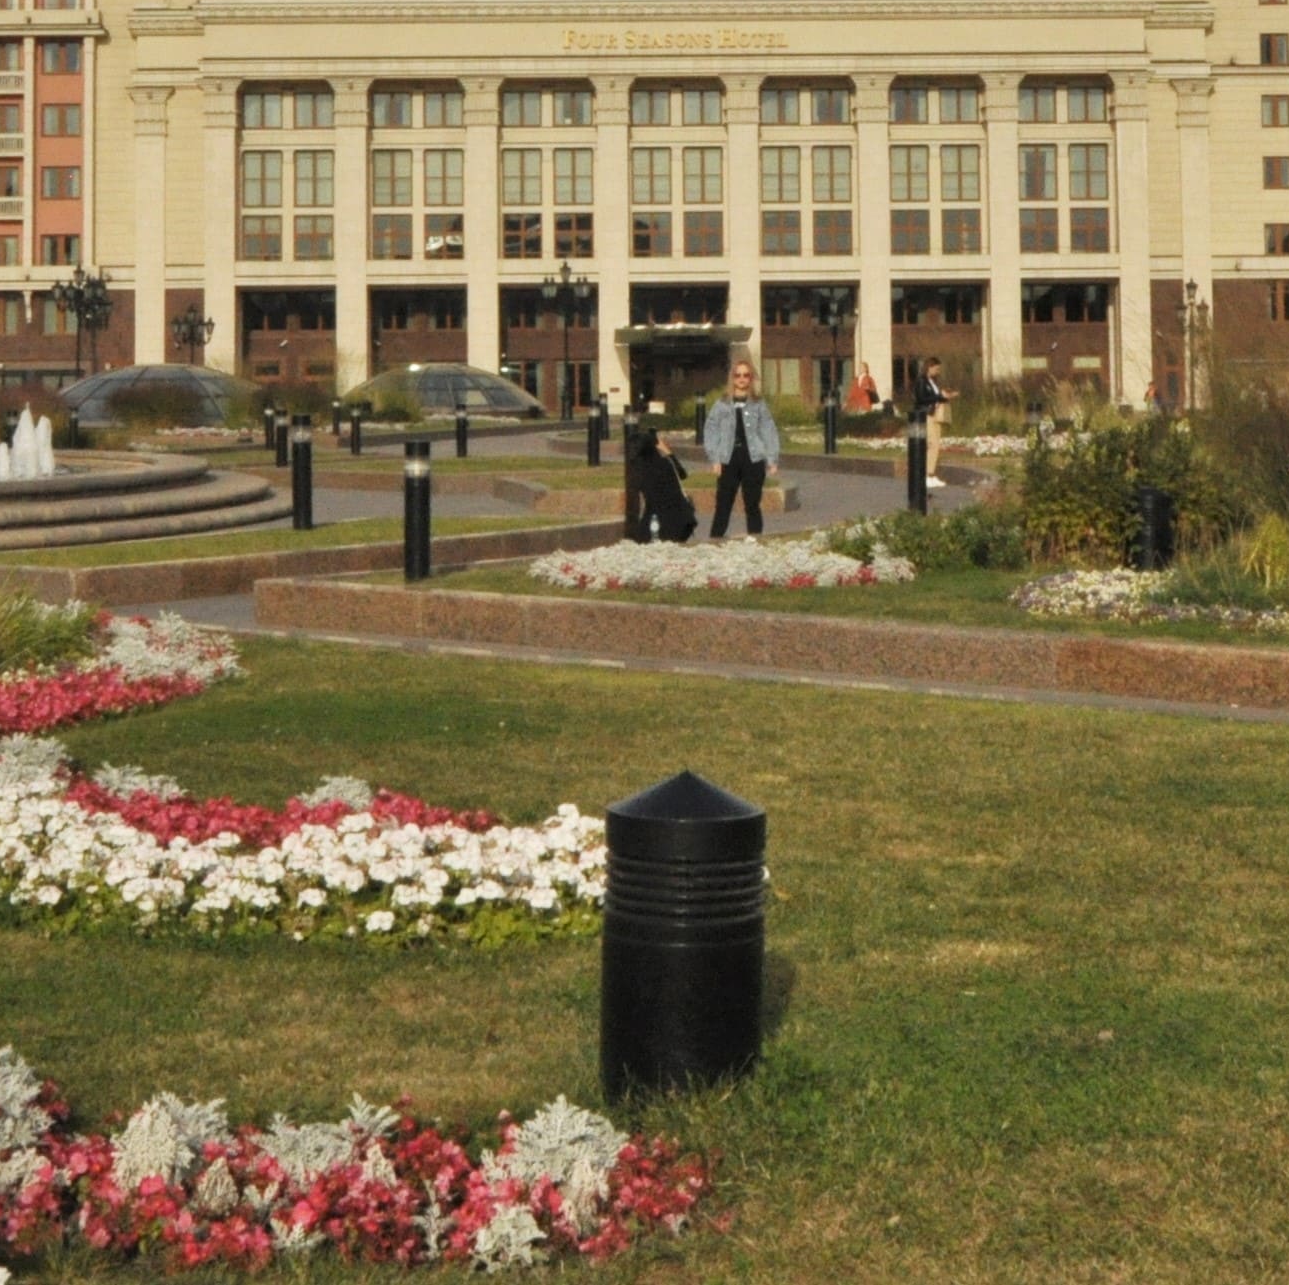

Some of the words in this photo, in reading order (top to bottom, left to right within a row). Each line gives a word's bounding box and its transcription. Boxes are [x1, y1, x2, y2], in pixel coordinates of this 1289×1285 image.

[562, 30, 618, 50] FOUR
[624, 30, 712, 50] SEASONS
[717, 29, 789, 49] HOTEL
